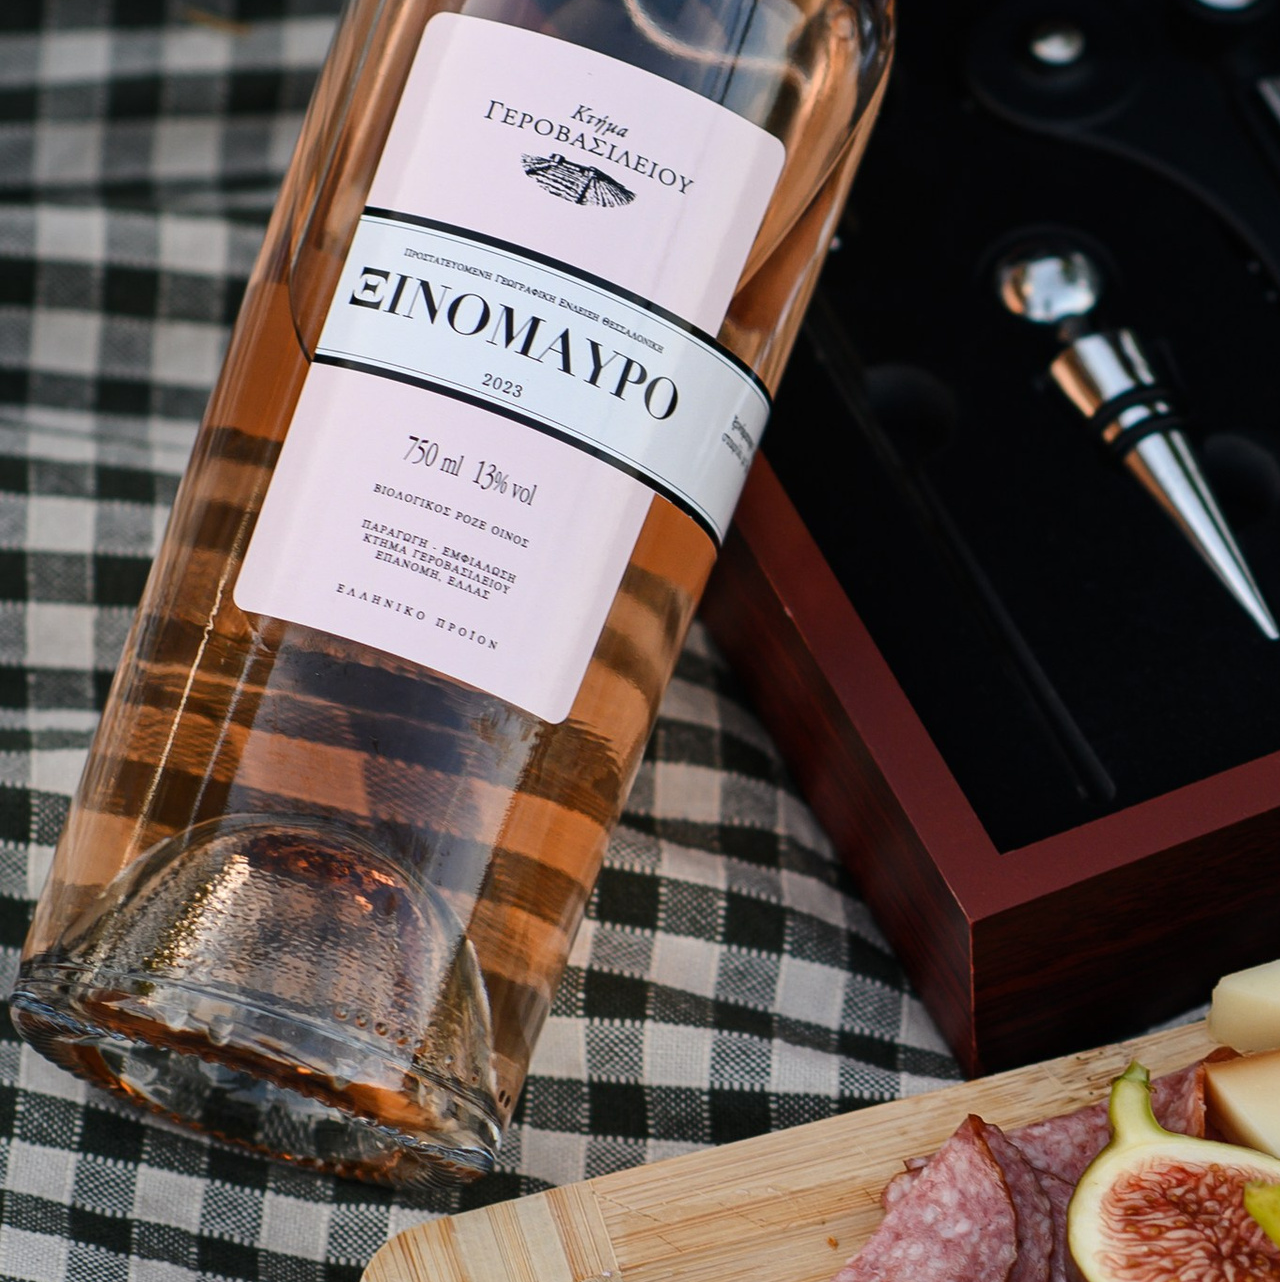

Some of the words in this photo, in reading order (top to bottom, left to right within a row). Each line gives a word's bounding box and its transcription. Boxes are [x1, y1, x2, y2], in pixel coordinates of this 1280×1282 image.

[484, 100, 694, 195] ΓΕΡΟΒΑΣΙΛΕΙΟΥ
[570, 104, 629, 138] Κτήμα
[404, 248, 493, 280] ΠΡΟΣΤΑΤΕΥΟΜΕΝΗ
[495, 275, 557, 304] ΓΕΩΓΡΑΦΙΚΗ
[348, 267, 679, 420] ΞΙΝΟΜΑΥΡΟ
[482, 373, 524, 398] 2023
[403, 435, 439, 467] 750
[440, 455, 465, 476] ml
[472, 461, 509, 494] 13%
[512, 483, 537, 506] vol
[373, 483, 452, 517] ΒΙΟΛΟΓΙΚΟΣ
[455, 511, 487, 530] ΡΟΖΕ
[491, 525, 530, 548] ΟΙΝΟΣ
[361, 519, 429, 549] ΠΑΡΑΓΩΓΗ
[442, 546, 517, 584] ΕΜΦΙΑΛΩΣΗ
[363, 533, 407, 555] ΚΤΗΜΑ
[412, 549, 511, 594] ΓΕΡΟΒΑΣΙΛΕΙΟΥ
[336, 583, 425, 620] ΕΛΛΗΝΙΚΟ
[447, 576, 491, 600] ΕΛΛΑΣ
